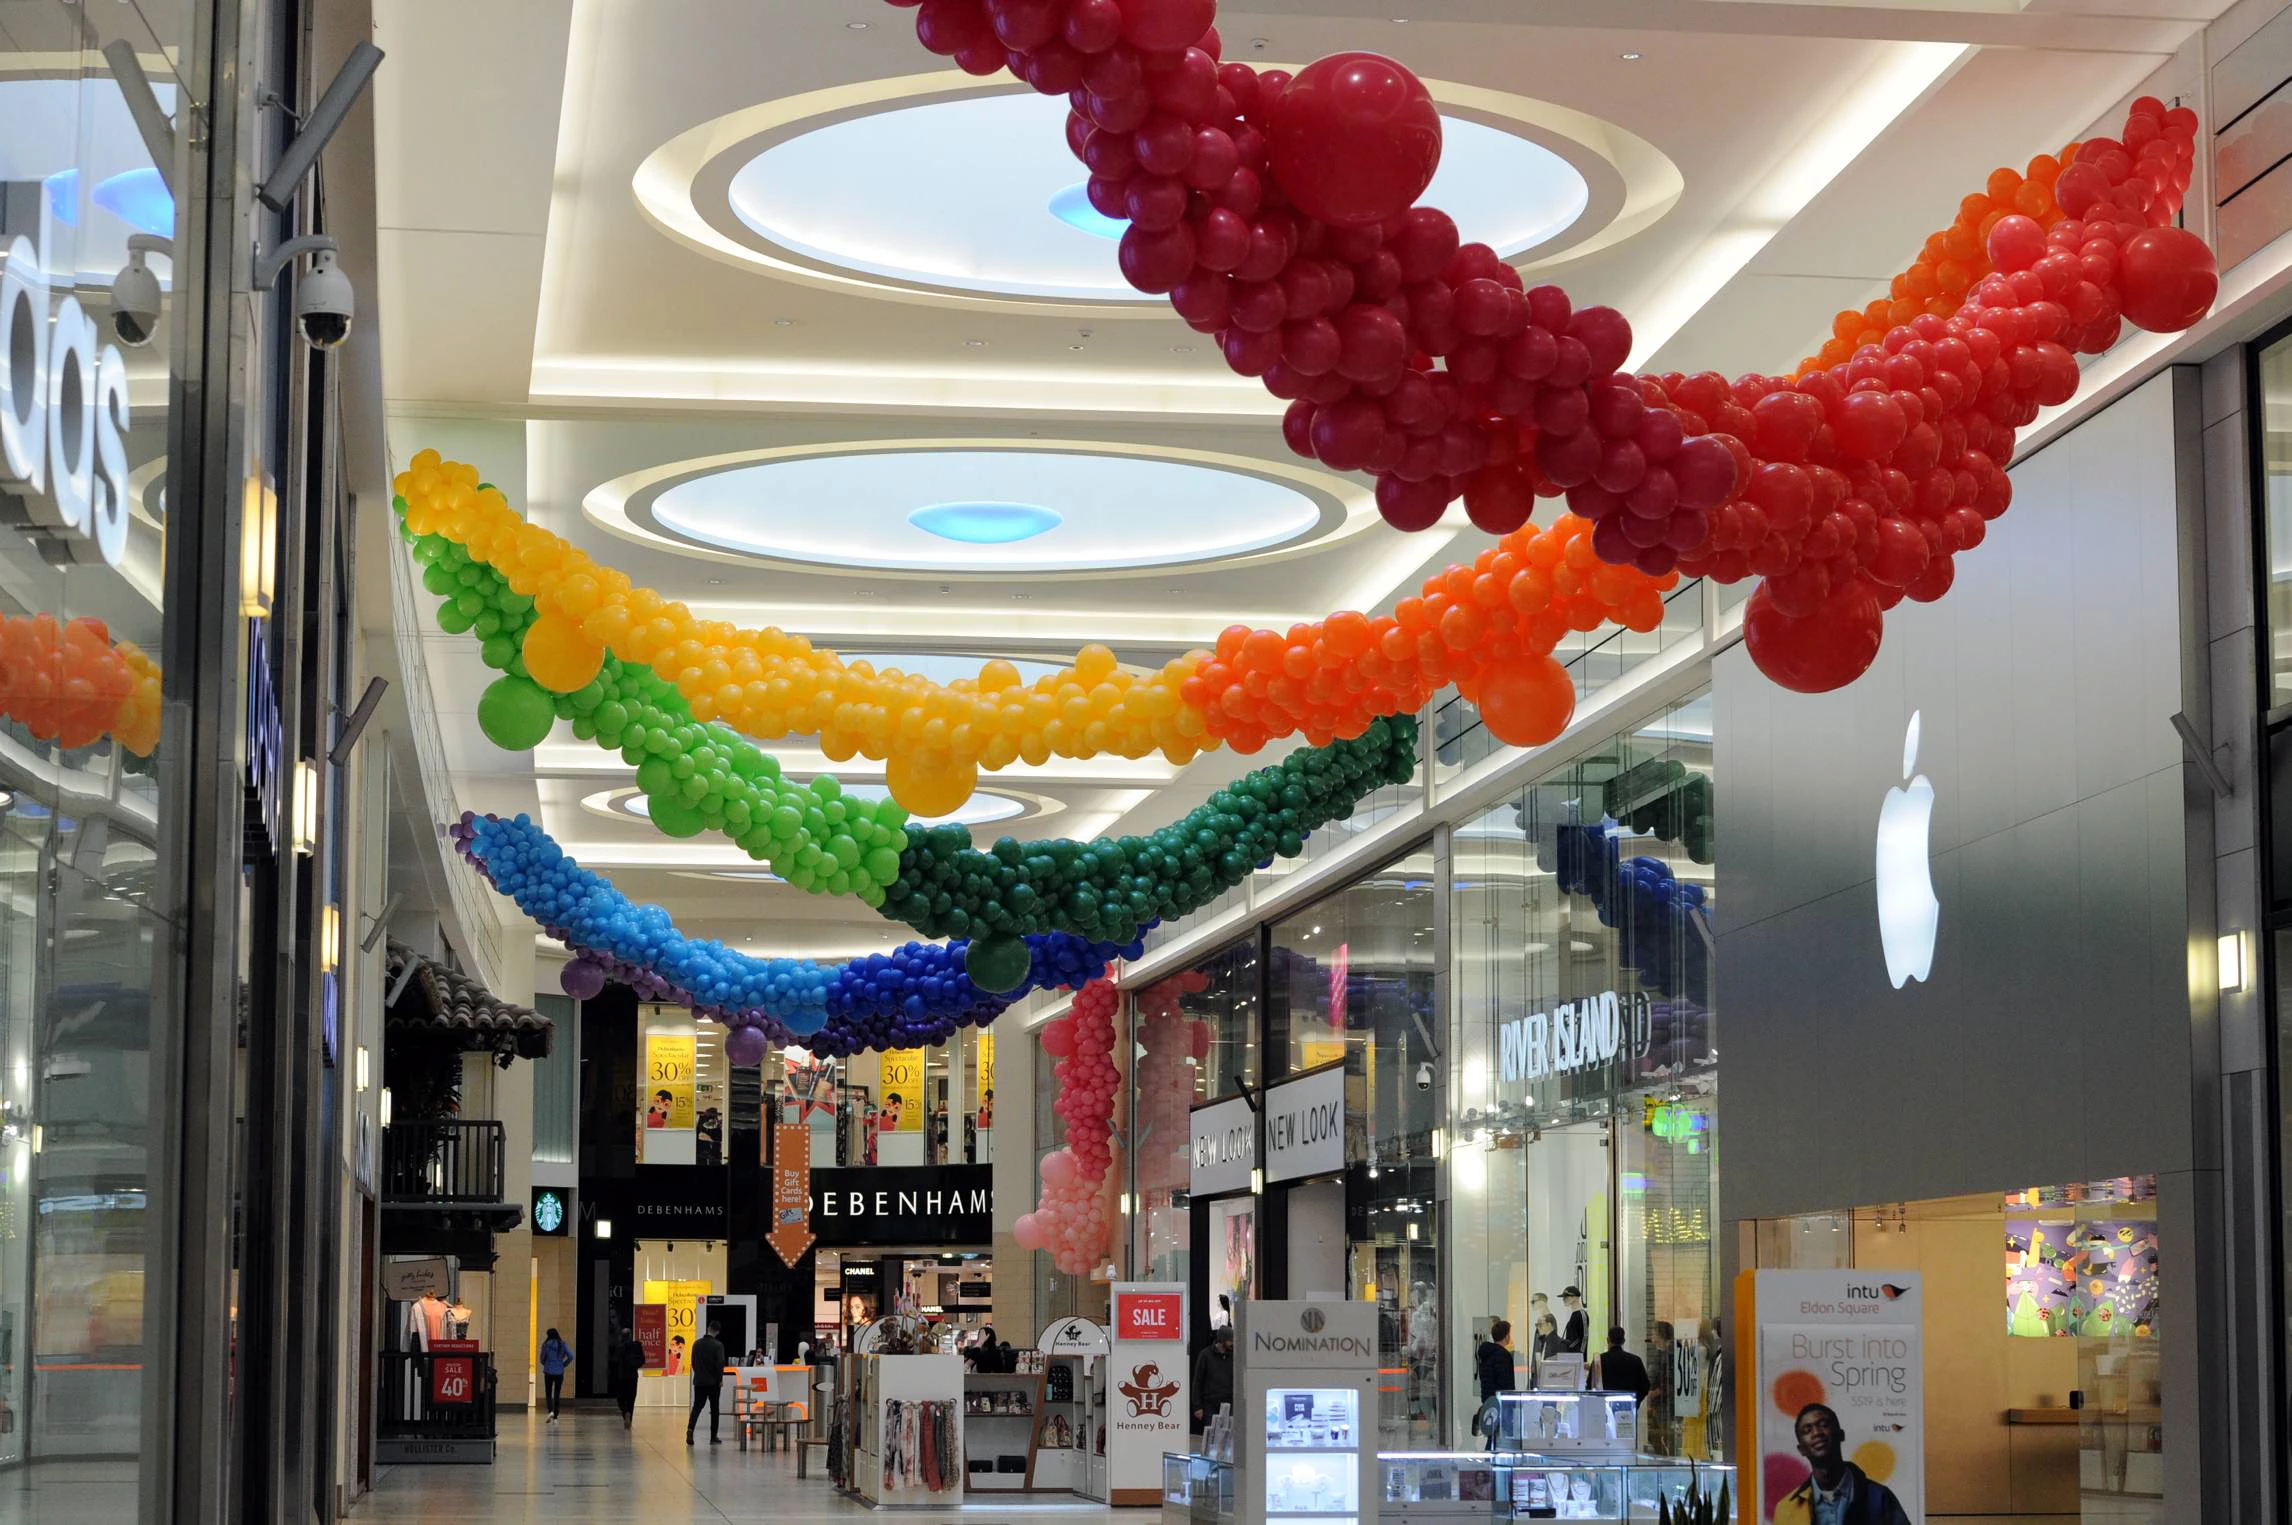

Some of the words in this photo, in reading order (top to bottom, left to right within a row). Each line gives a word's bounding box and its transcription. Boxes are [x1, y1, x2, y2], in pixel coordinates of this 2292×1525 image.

[1501, 1012, 1549, 1083] RIVER
[1553, 990, 1620, 1072] ISLAND
[651, 1061, 691, 1081] 30%
[882, 1064, 920, 1085] 30%
[1268, 1112, 1296, 1152] NEW
[1302, 1100, 1338, 1145] LOOK
[1193, 1132, 1217, 1168] NEW
[1222, 1124, 1252, 1163] LOOK
[784, 1169, 800, 1178] Buy
[784, 1178, 800, 1187] Gift
[780, 1187, 802, 1195] Cards
[781, 1194, 801, 1203] here!
[637, 1205, 724, 1216] DEBENHAMS
[808, 1189, 993, 1216] EBENHAM
[844, 1267, 875, 1276] CHANEL
[1847, 1283, 1879, 1299] intu
[1801, 1301, 1835, 1314] Eldon
[1839, 1301, 1880, 1316] Square
[1132, 1308, 1166, 1326] SALE
[639, 1327, 661, 1340] half
[1255, 1332, 1371, 1357] NOMINATION
[1793, 1333, 1854, 1360] Burst
[1862, 1333, 1907, 1360] into
[1831, 1361, 1906, 1394] Spring
[1116, 1421, 1155, 1432] Henney
[1158, 1421, 1181, 1430] Bear
[1873, 1424, 1890, 1433] intu
